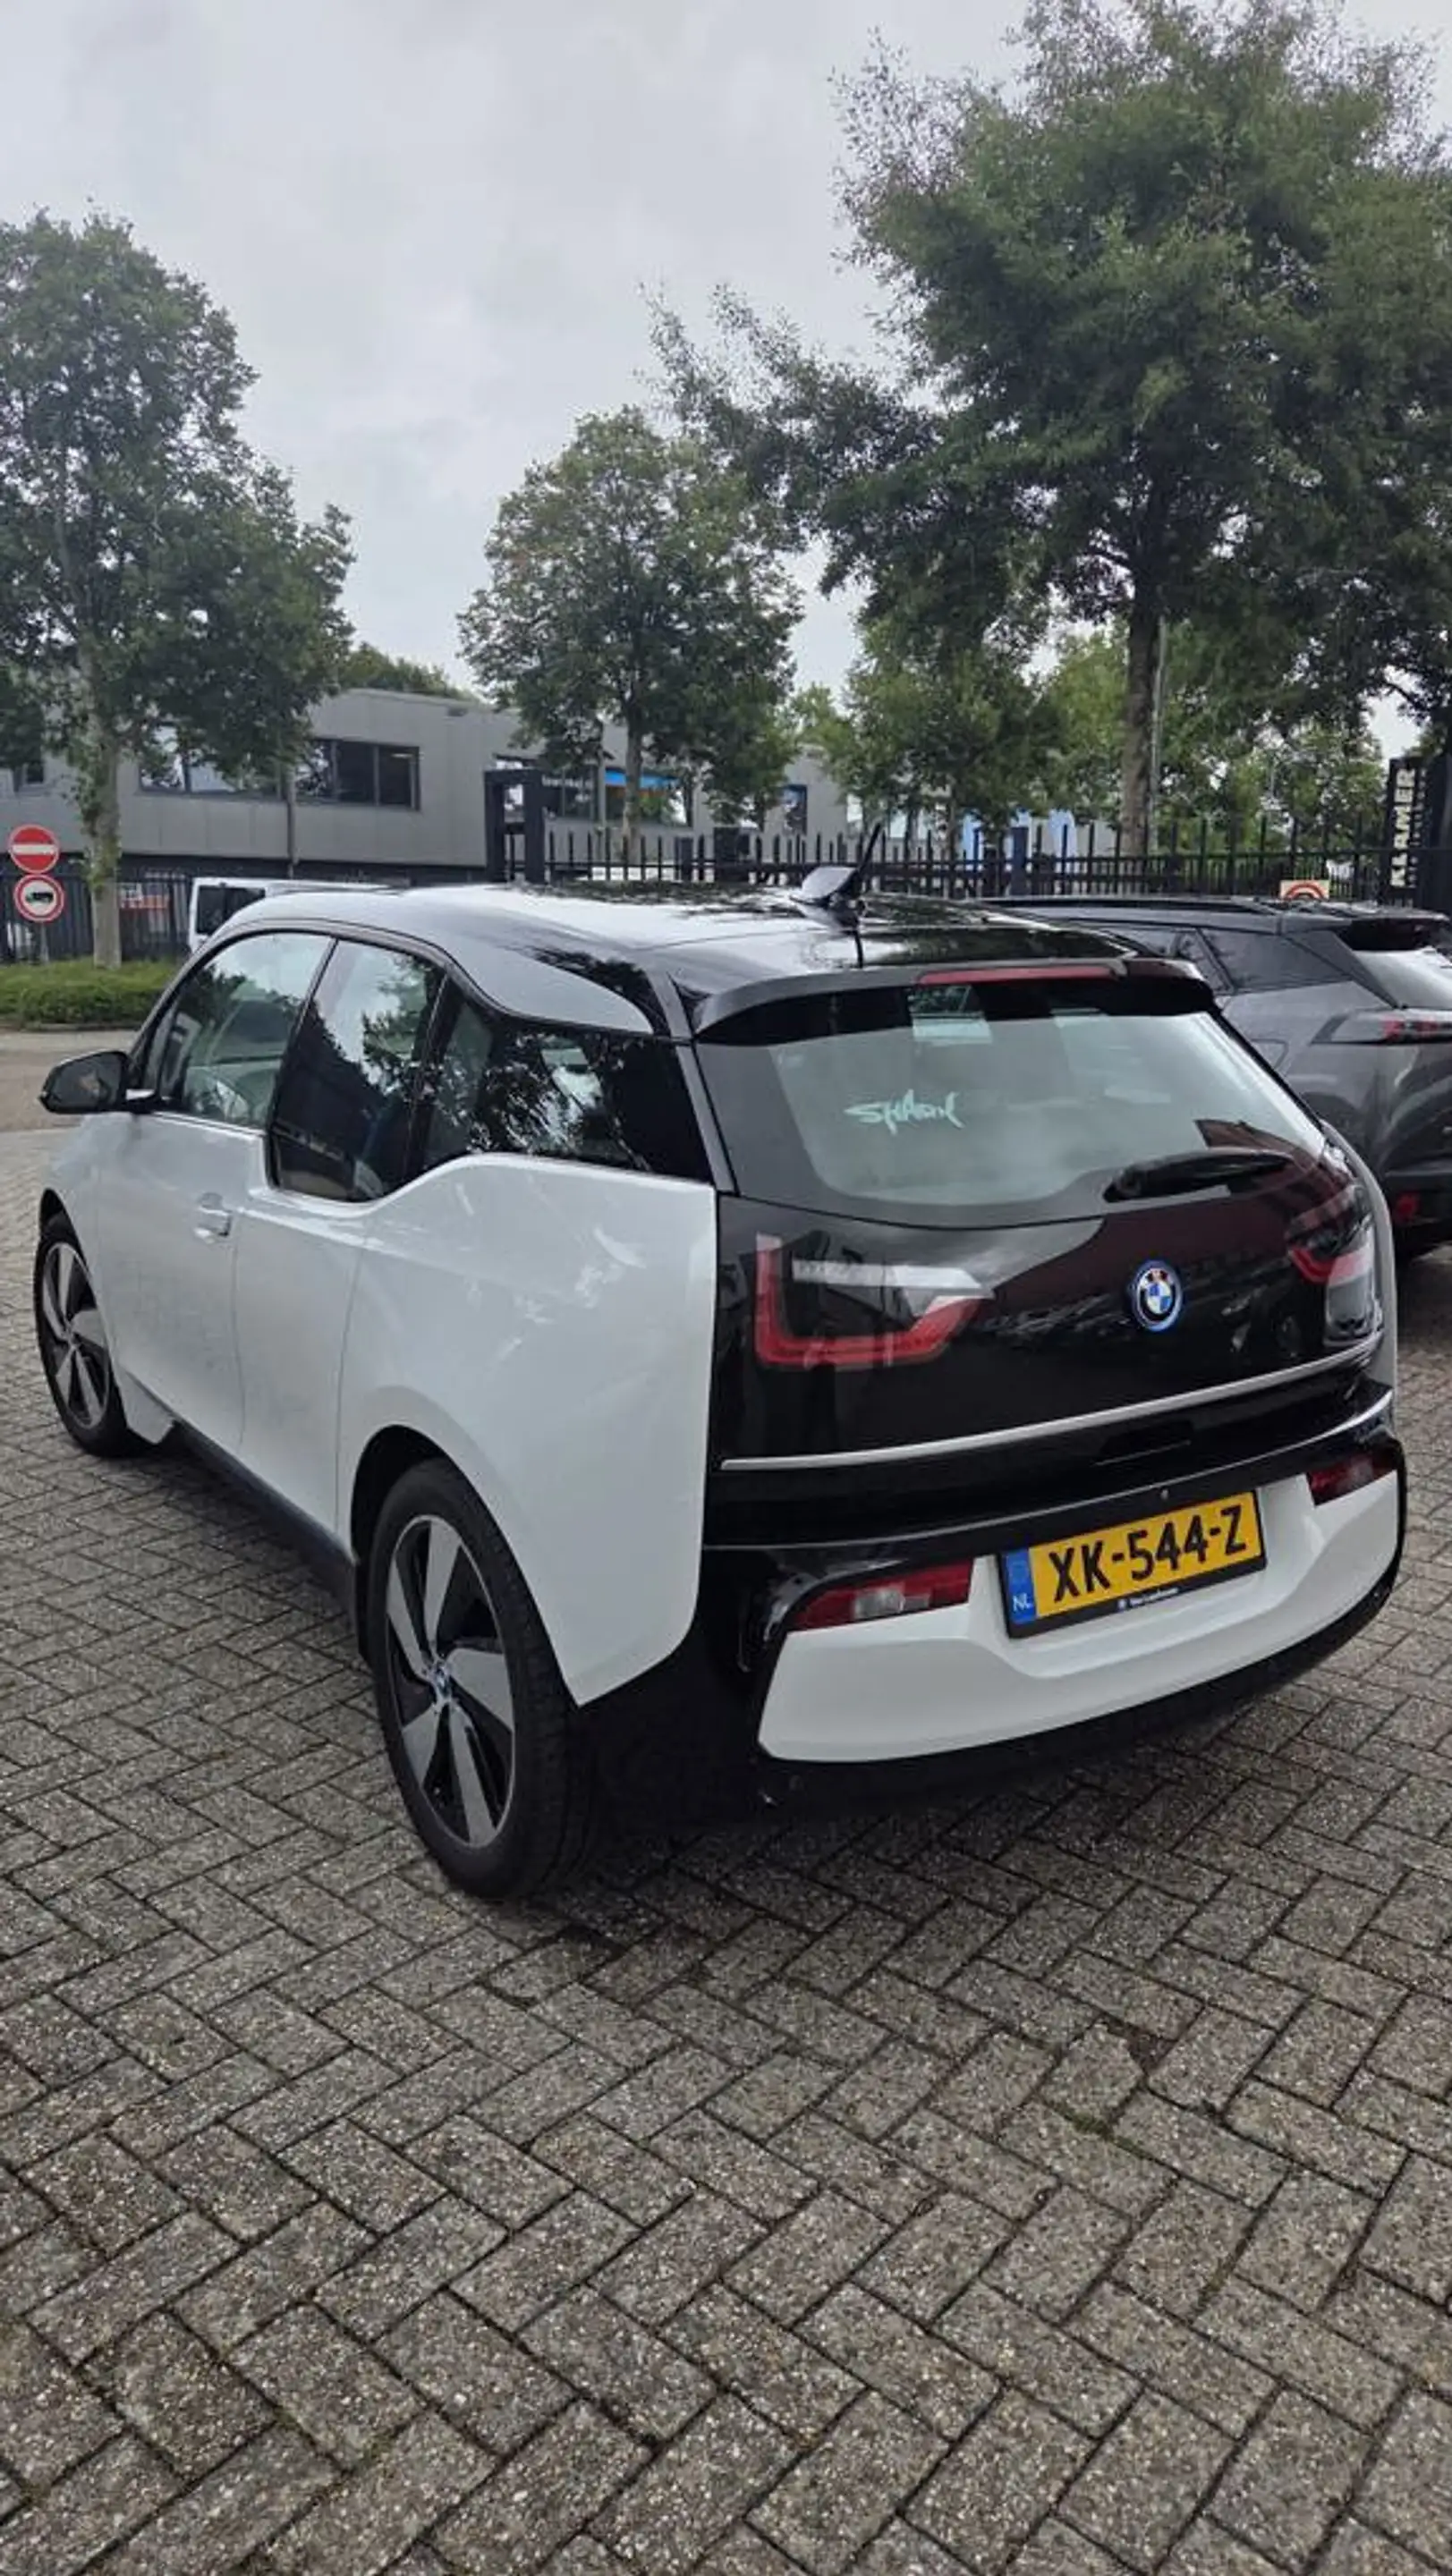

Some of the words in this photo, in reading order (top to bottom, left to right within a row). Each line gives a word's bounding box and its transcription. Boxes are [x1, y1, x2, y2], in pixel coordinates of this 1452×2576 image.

[1390, 768, 1415, 887] KLAMER
[1012, 1593, 1032, 1612] NL
[1049, 1505, 1246, 1603] XK-544-Z
